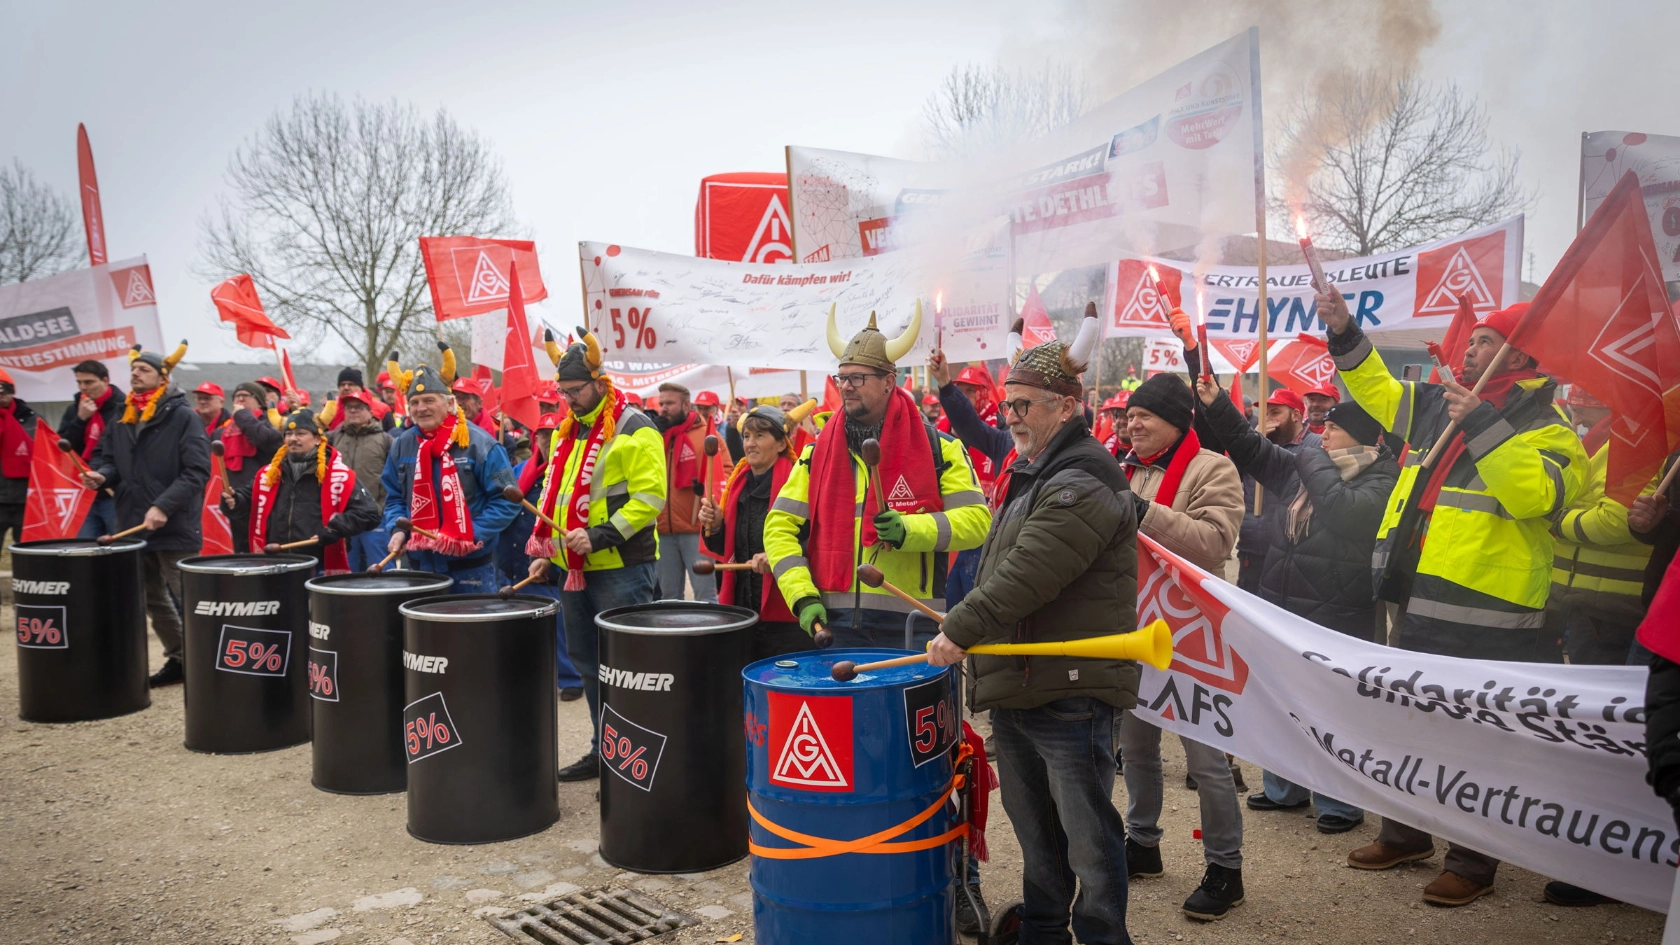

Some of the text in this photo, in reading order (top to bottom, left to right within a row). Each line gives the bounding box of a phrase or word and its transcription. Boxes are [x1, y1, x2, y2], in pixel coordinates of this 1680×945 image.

[1181, 117, 1225, 134] MehrWert
[1185, 133, 1201, 144] mit
[1027, 151, 1102, 183] STARK!
[1040, 174, 1159, 218] DETHLS
[742, 270, 852, 287] Dafür kämpfen wir!
[1204, 255, 1411, 287] ERTRAUESLEUTE
[941, 302, 1000, 318] OLIDARITÄT
[953, 314, 1000, 328] GEWINNT
[1233, 290, 1384, 332] HYMR
[610, 307, 657, 350] 5%
[207, 601, 280, 616] HYMER
[18, 616, 61, 644] 5%
[309, 620, 330, 640] MER
[223, 640, 282, 671] 5%
[605, 667, 675, 692] HYMER
[1302, 651, 1580, 719] lidarität
[1138, 664, 1234, 738] LAFS
[406, 712, 450, 755] 5%
[915, 694, 955, 754] 5%
[1516, 712, 1648, 758] Stär
[602, 723, 648, 780] 5%
